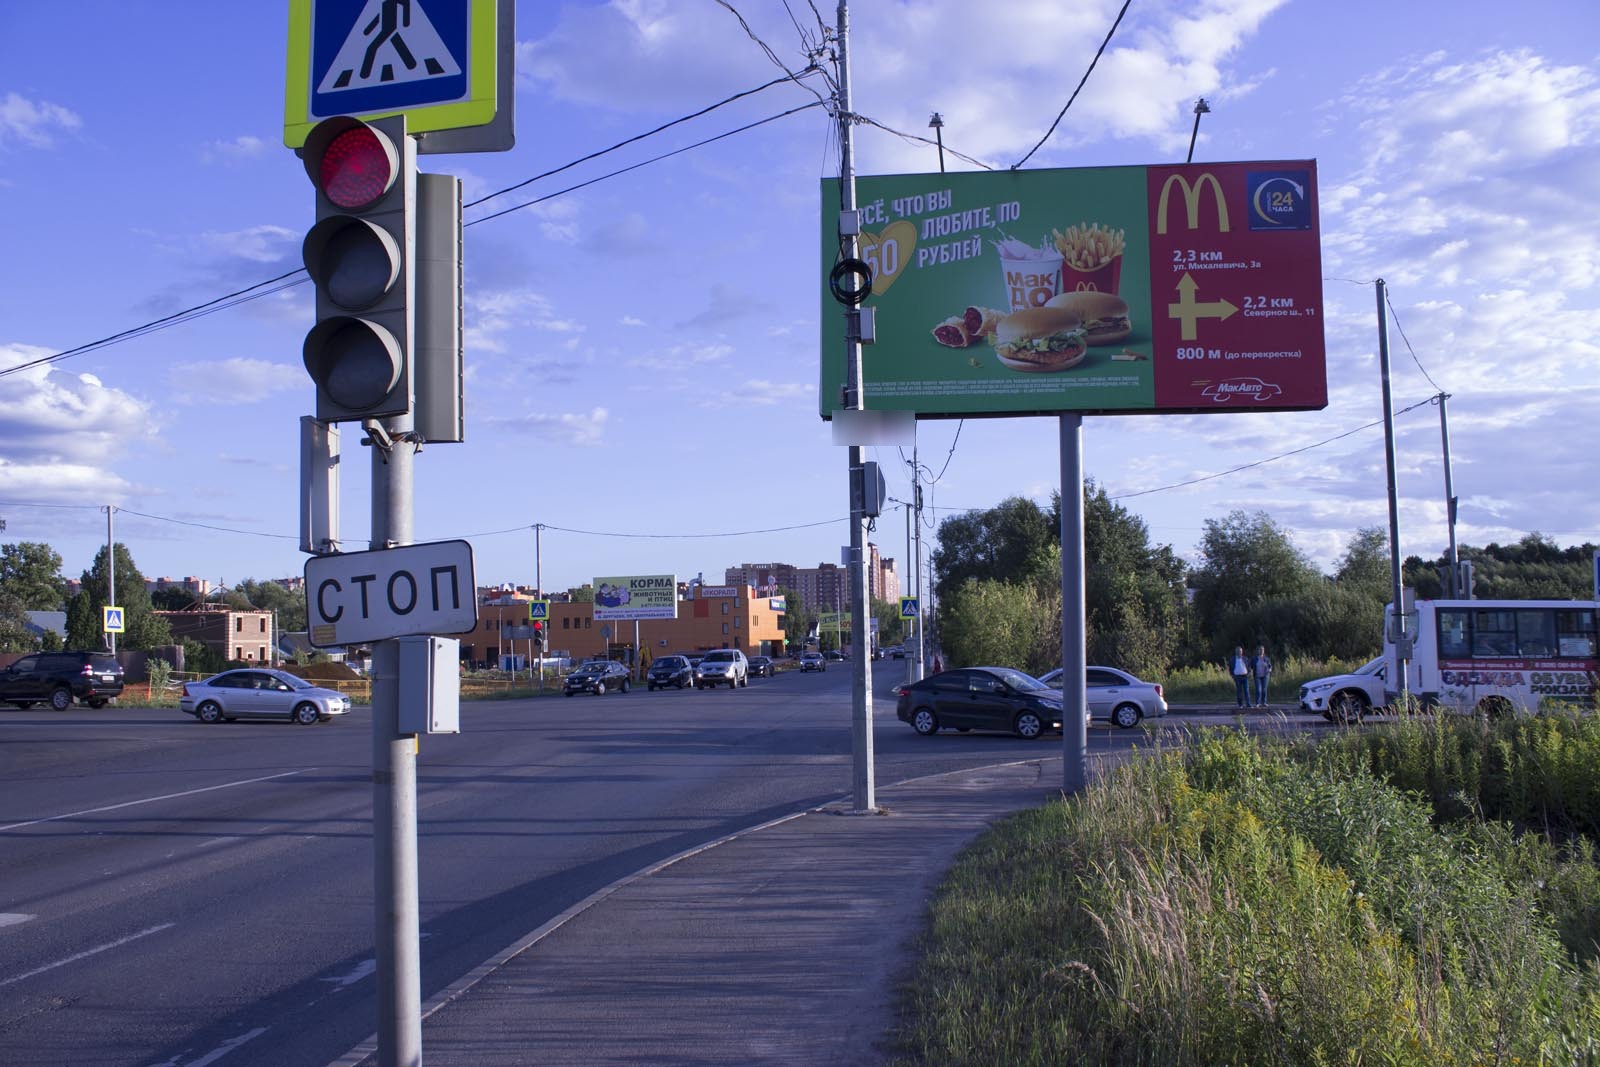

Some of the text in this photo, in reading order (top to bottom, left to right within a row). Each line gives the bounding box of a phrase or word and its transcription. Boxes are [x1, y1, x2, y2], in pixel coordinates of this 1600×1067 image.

[892, 195, 924, 217] ЧТО
[925, 189, 952, 211] ВЫ
[1272, 192, 1294, 206] 24
[921, 201, 1021, 240] ЛЮБИТЕ, ПО
[917, 234, 982, 268] РУБЛЕЙ
[1173, 250, 1196, 262] 2,3
[1173, 263, 1187, 272] ул.
[1188, 261, 1248, 271] Михалевича,
[1243, 296, 1267, 309] 2,2
[1243, 309, 1288, 318] Северное
[1305, 308, 1315, 316] 11
[1176, 347, 1204, 360] 800
[1224, 351, 1240, 361] (до
[1241, 350, 1302, 360] перекрестка)
[1217, 383, 1263, 393] МакАвто
[630, 578, 672, 588] КОРМА
[317, 565, 460, 623] СТОП
[1441, 671, 1526, 687] ОДЕЖДА
[1530, 672, 1588, 685] ОБУВЬ
